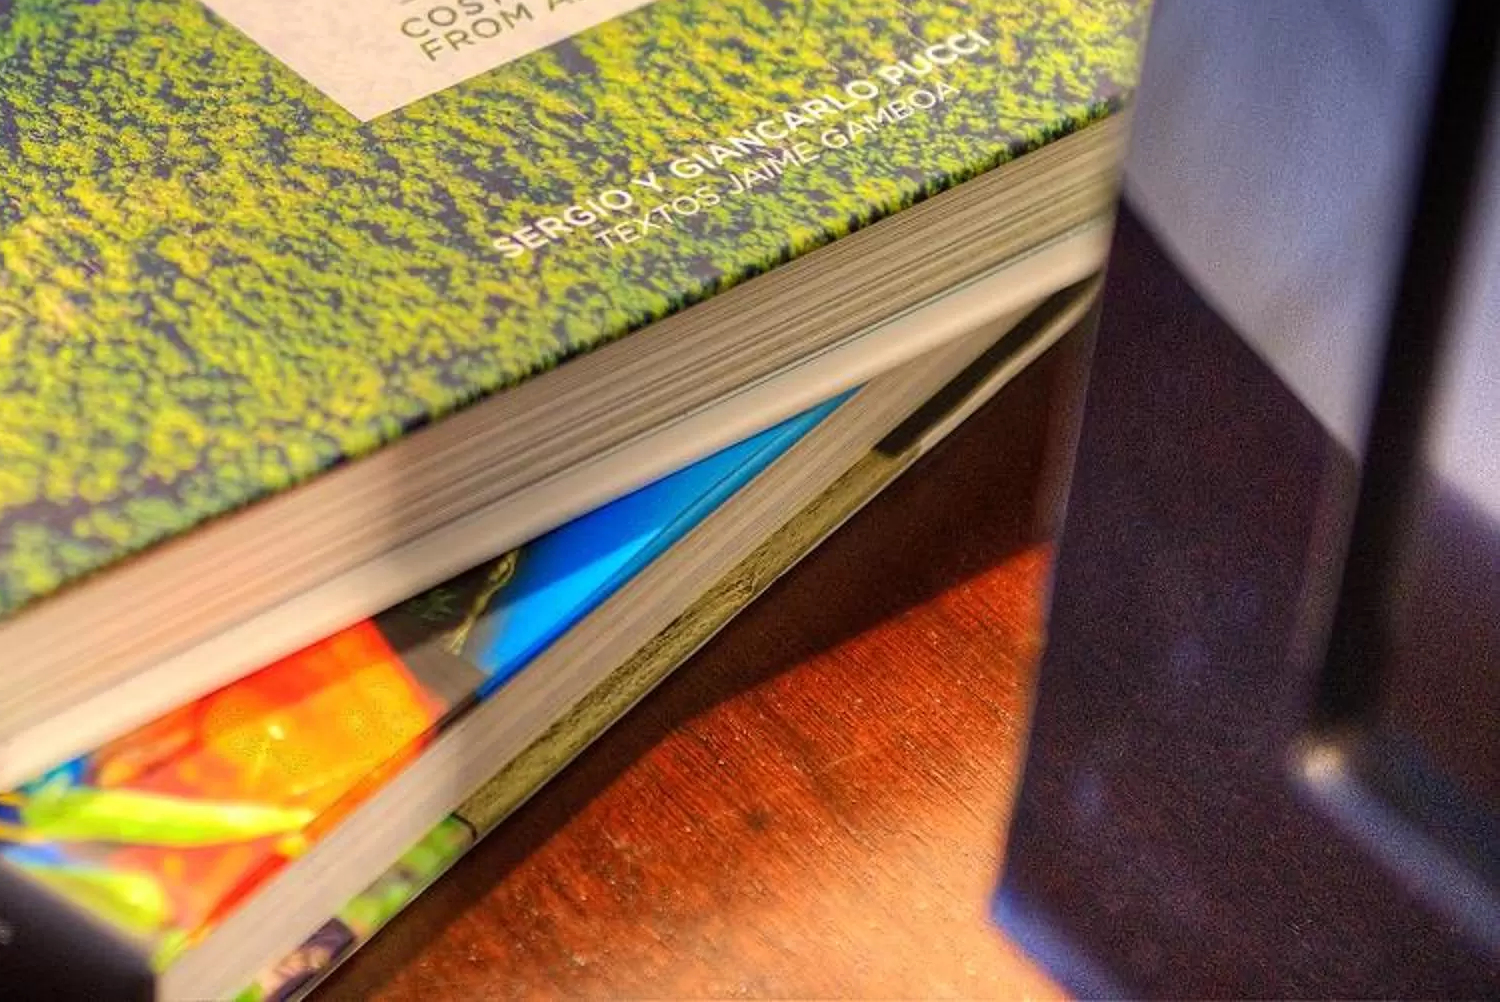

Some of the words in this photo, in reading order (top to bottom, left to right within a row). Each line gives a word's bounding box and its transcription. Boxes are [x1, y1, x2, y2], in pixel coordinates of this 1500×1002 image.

[420, 1, 536, 62] FROM
[492, 188, 634, 260] SERGIO
[631, 169, 665, 195] Y
[668, 78, 880, 180] GIANCARLO
[883, 28, 993, 94] PUCCI
[595, 185, 722, 251] TEXTOS
[725, 140, 822, 198] JAIME
[821, 78, 961, 151] GAMBOA
